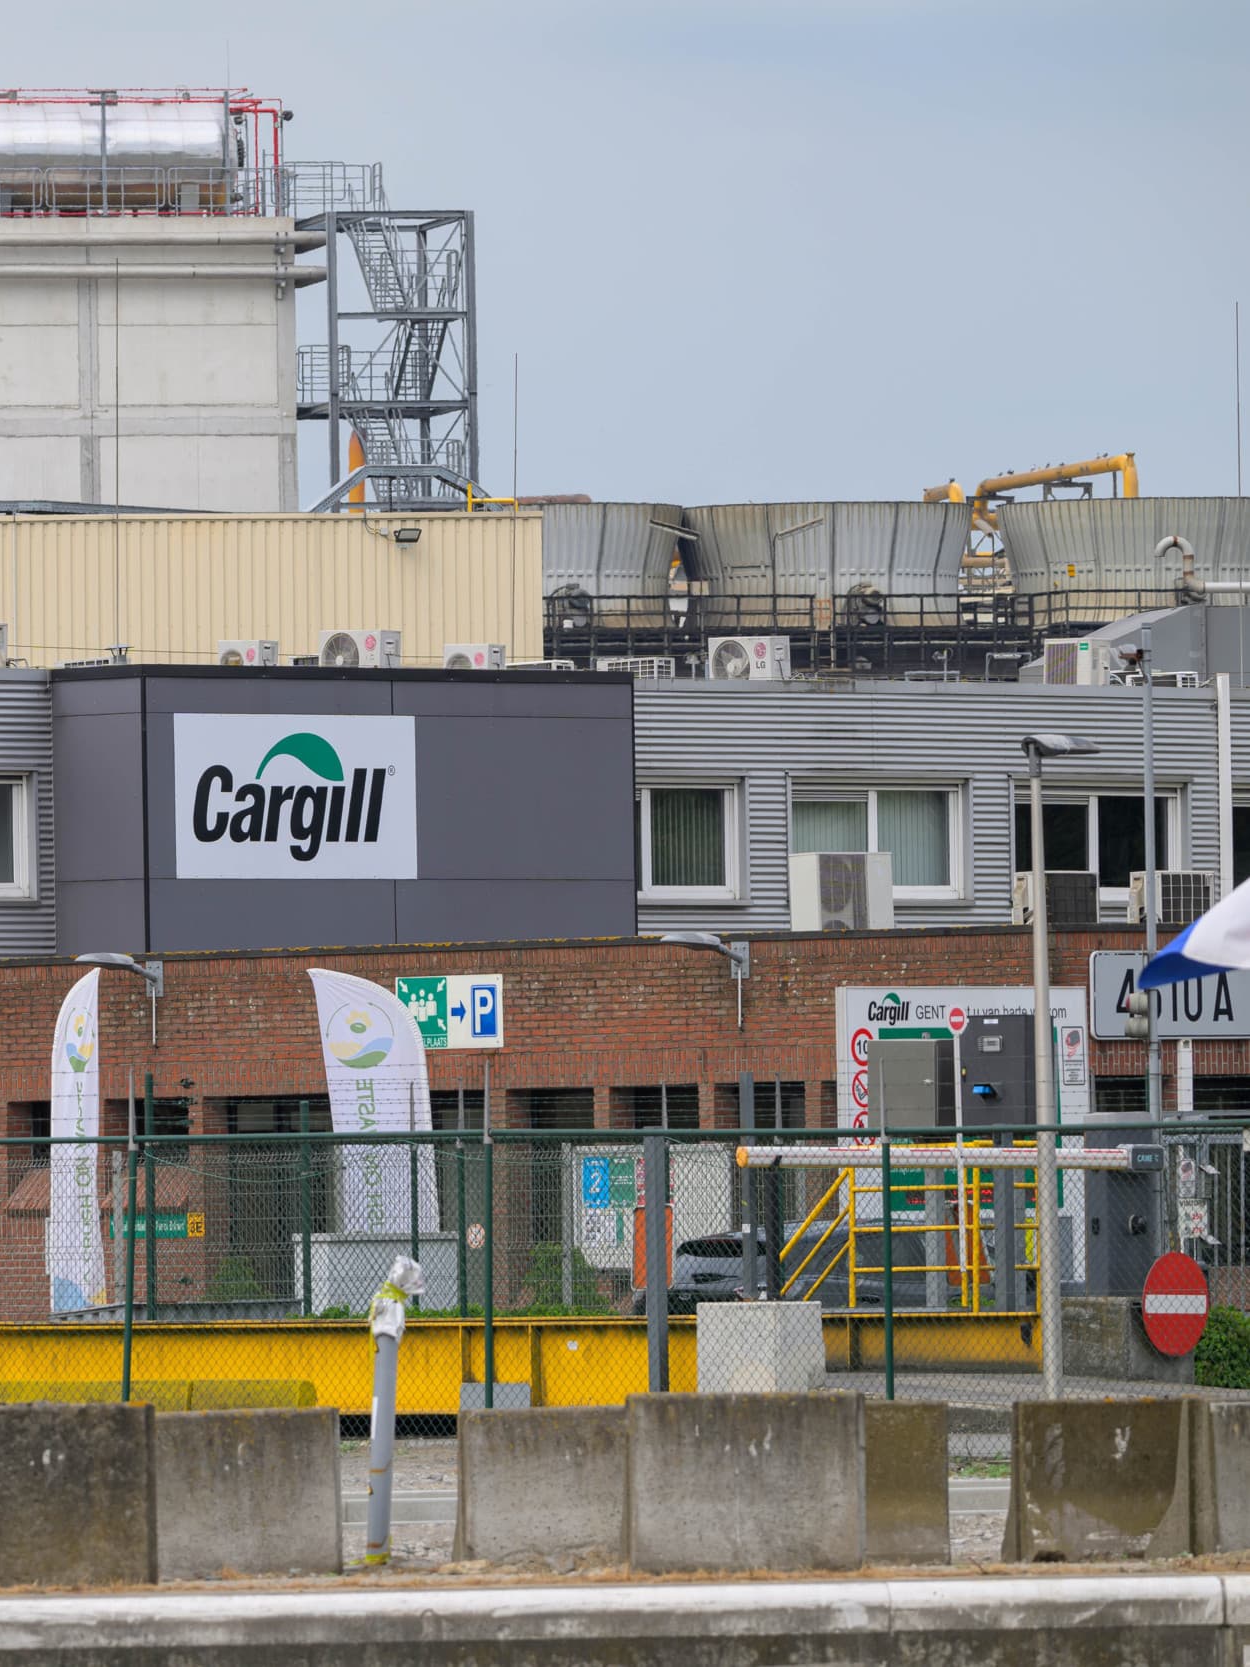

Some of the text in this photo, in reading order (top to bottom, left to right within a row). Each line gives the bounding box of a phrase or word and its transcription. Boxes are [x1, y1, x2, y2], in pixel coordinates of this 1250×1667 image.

[755, 661, 766, 669] LG
[193, 764, 387, 862] Cargill
[474, 988, 494, 1034] P
[868, 1000, 910, 1026] Cargill
[915, 1005, 946, 1020] GENT
[74, 1157, 91, 1187] ON
